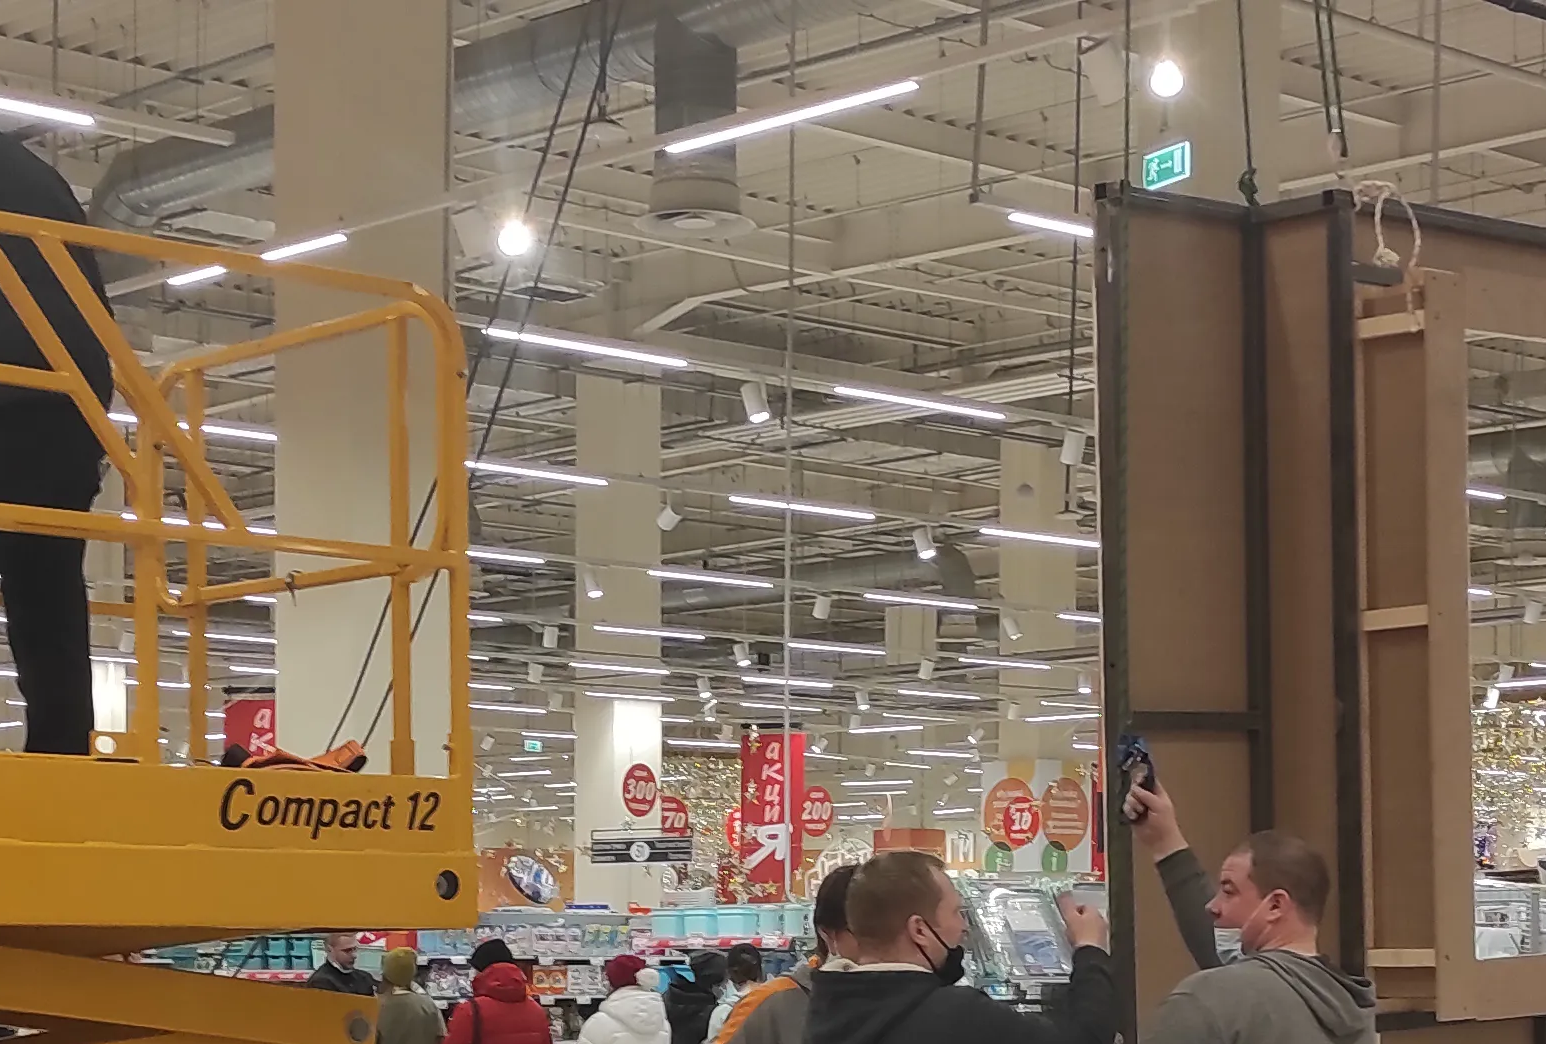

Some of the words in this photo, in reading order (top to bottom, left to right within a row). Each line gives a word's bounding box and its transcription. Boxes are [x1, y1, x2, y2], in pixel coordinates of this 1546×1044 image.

[624, 779, 656, 801] 300
[219, 778, 396, 840] Compact
[406, 791, 442, 831] 12
[801, 800, 832, 821] 200
